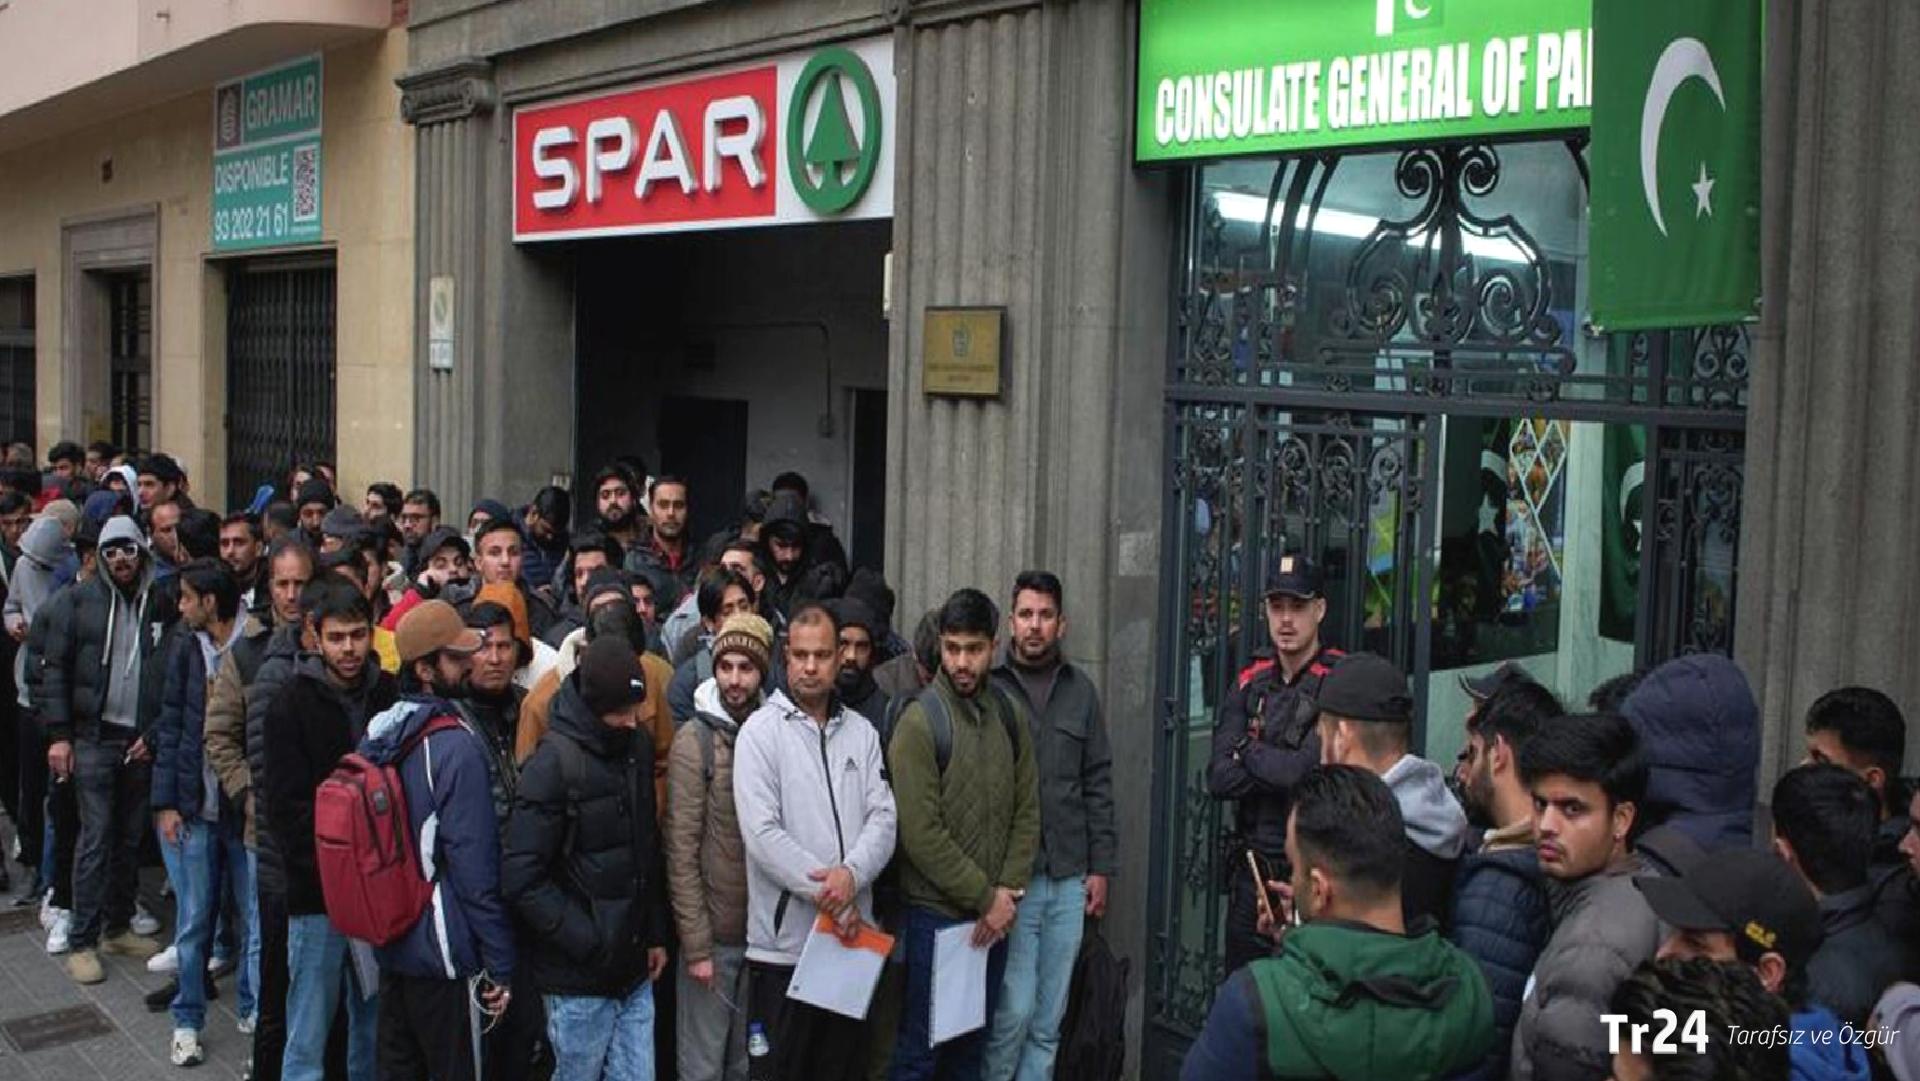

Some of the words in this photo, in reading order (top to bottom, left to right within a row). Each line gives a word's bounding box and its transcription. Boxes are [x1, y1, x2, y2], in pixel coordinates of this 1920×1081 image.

[246, 74, 315, 129] GRAMAR
[1155, 61, 1321, 145] CONSULATE
[1328, 43, 1472, 129] GENERAL
[1482, 36, 1528, 117] OF
[215, 152, 288, 194] DISPONIBLE
[532, 95, 766, 209] SPAR
[215, 211, 229, 240] 93
[232, 207, 253, 240] 202
[256, 206, 270, 237] 21
[274, 202, 288, 237] 61
